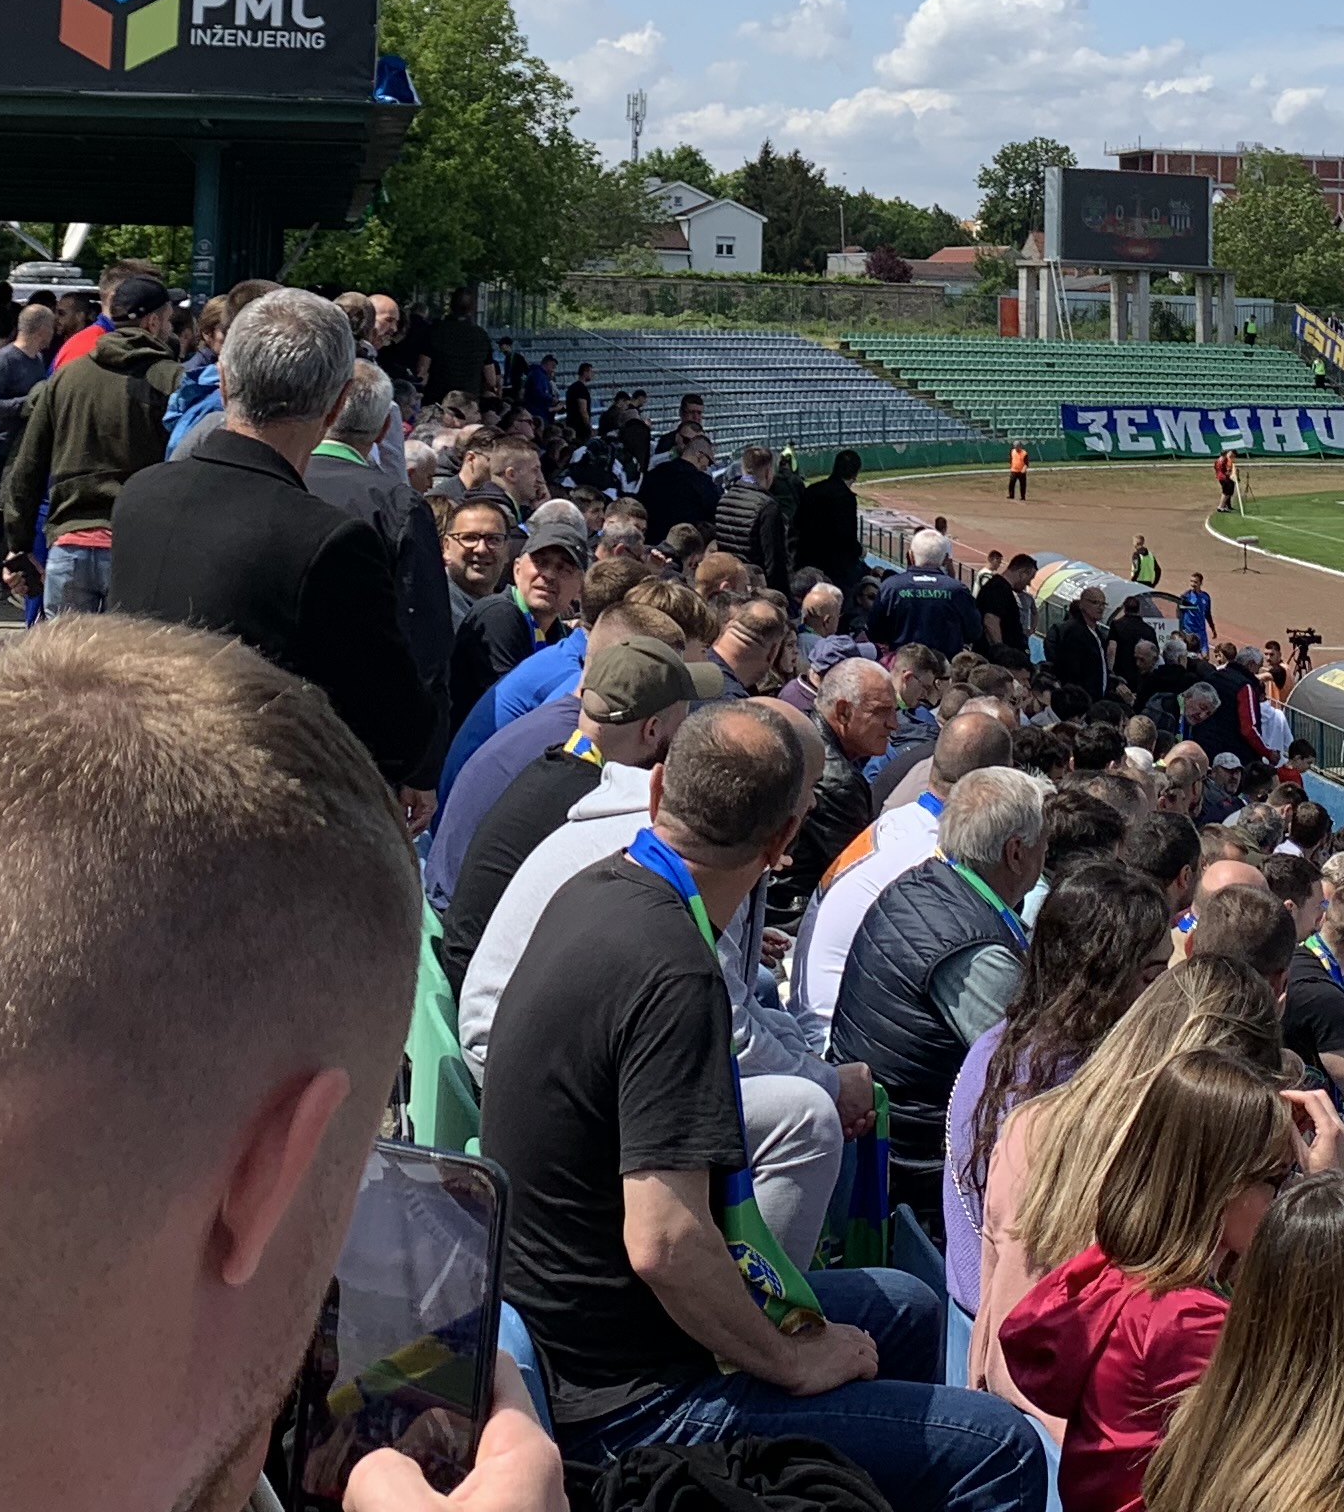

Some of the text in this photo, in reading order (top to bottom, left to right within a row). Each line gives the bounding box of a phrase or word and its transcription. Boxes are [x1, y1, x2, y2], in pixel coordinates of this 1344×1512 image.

[190, 25, 327, 49] INŽENJERING
[898, 589, 952, 600] ФК ЗЕМУН
